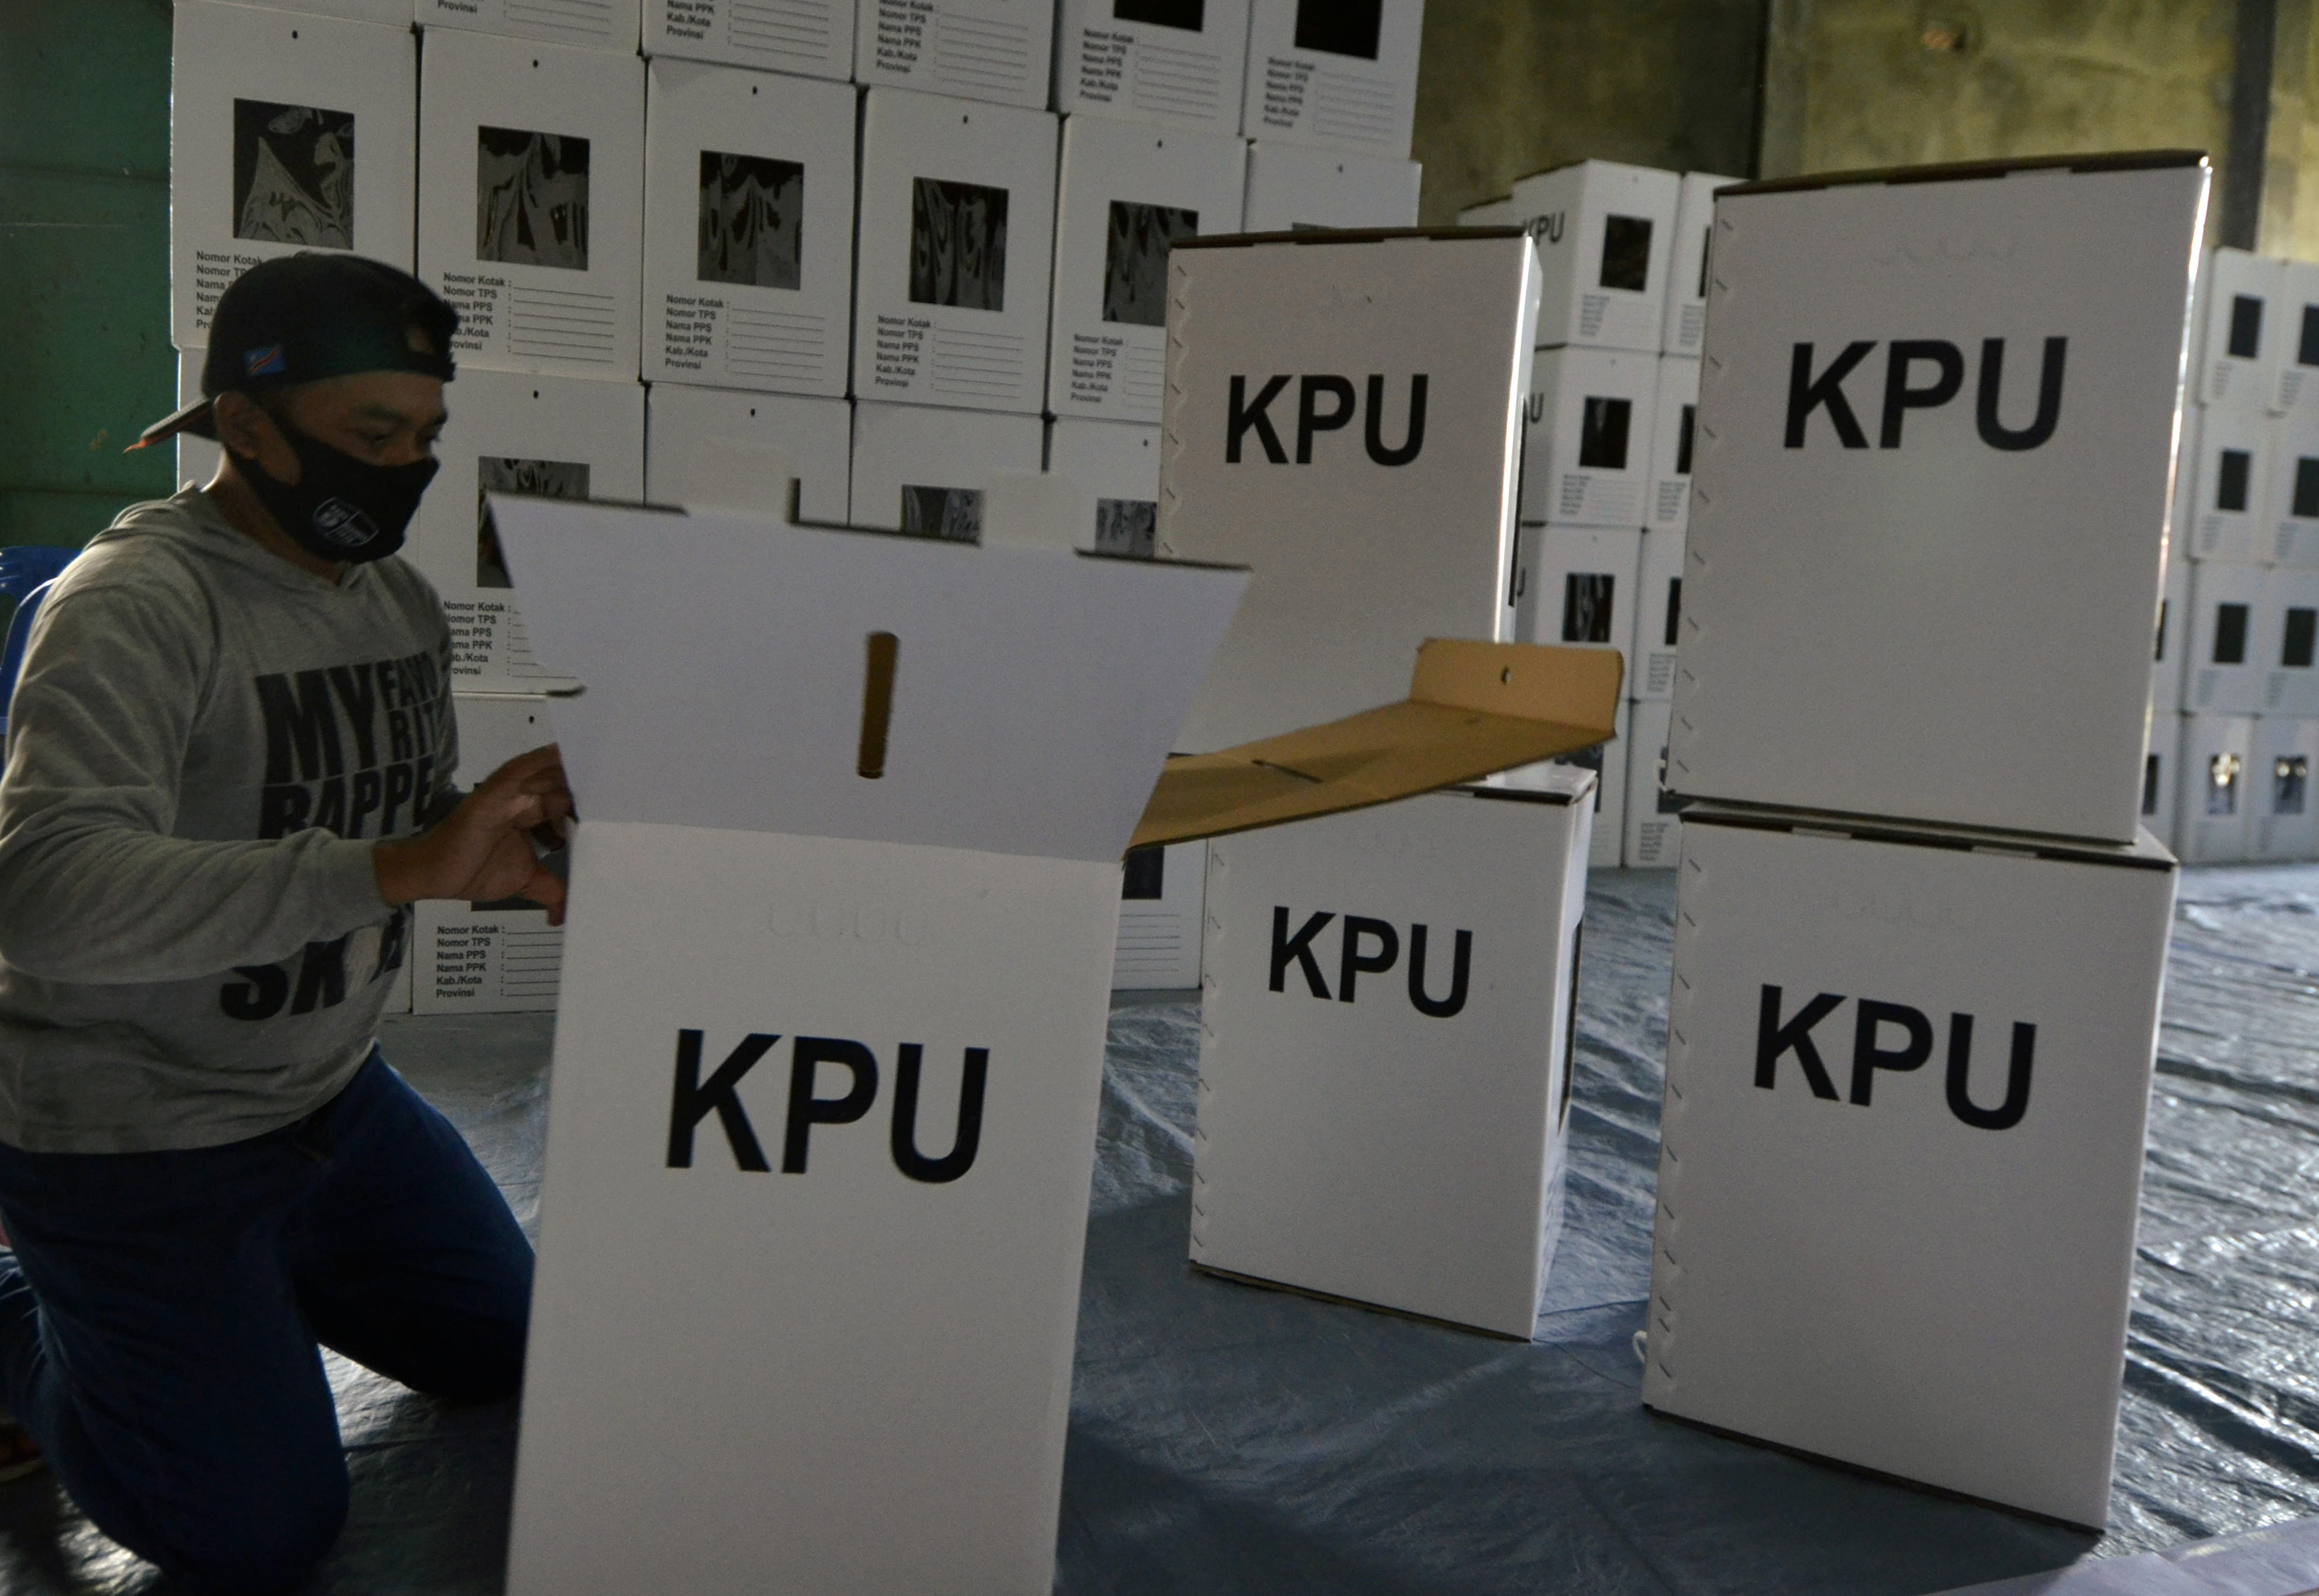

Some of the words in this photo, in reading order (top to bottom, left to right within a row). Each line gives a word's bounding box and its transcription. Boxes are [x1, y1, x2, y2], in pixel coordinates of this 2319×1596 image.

[197, 250, 230, 263] Nomor
[197, 264, 231, 276] Nomor
[234, 267, 248, 277] TP
[197, 278, 226, 289] Nama
[444, 272, 475, 284] Nomor
[478, 275, 505, 286] Kotak
[197, 292, 220, 302] Nam
[444, 285, 475, 297] Nomor
[478, 288, 497, 299] TPS
[473, 301, 493, 312] PPS
[667, 294, 696, 306] Nomor
[699, 297, 724, 308] Kotak
[667, 307, 696, 318] Nomor
[698, 309, 716, 320] TPS
[473, 314, 493, 325] PPK
[666, 319, 691, 330] Nama
[694, 322, 712, 332] PPS
[666, 333, 690, 343] Nama
[693, 335, 712, 345] PPK
[450, 340, 482, 351] rovinsi
[665, 358, 701, 369] Provinsi
[1784, 336, 2068, 451] KPU
[1226, 374, 1429, 466] KPU
[444, 601, 475, 611] Nomor
[478, 602, 505, 612] Kotak
[478, 615, 496, 624] TPS
[452, 628, 470, 637] ama
[472, 627, 492, 637] PPS
[472, 640, 492, 650] PPK
[255, 663, 377, 786] MY
[437, 926, 468, 935] Nomor
[471, 925, 499, 934] Kotak
[437, 939, 468, 947] Nomor
[471, 937, 490, 947] TPS
[437, 951, 464, 960] Nama
[466, 950, 486, 959] PPS
[1269, 906, 1472, 1017] KPU
[437, 964, 463, 972] Nama
[466, 963, 486, 971] PPK
[436, 988, 474, 997] Provinsi
[1754, 983, 2037, 1130] KPU
[667, 1028, 989, 1183] KPU
